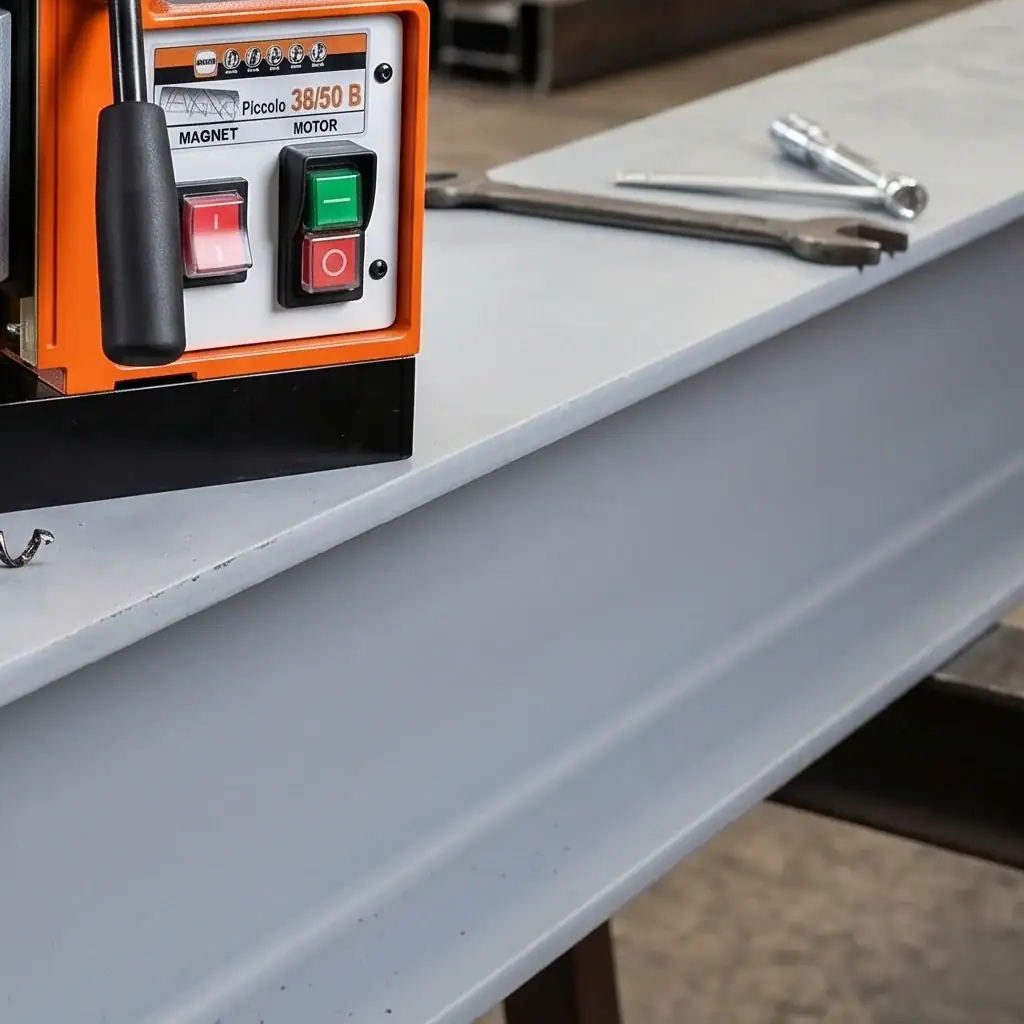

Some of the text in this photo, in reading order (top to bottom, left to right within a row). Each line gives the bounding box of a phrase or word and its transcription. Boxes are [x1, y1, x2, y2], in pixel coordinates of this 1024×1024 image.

[242, 83, 362, 116] Piccolo 38/50 B
[293, 118, 337, 135] MOTOR
[179, 127, 238, 145] MAGNET
